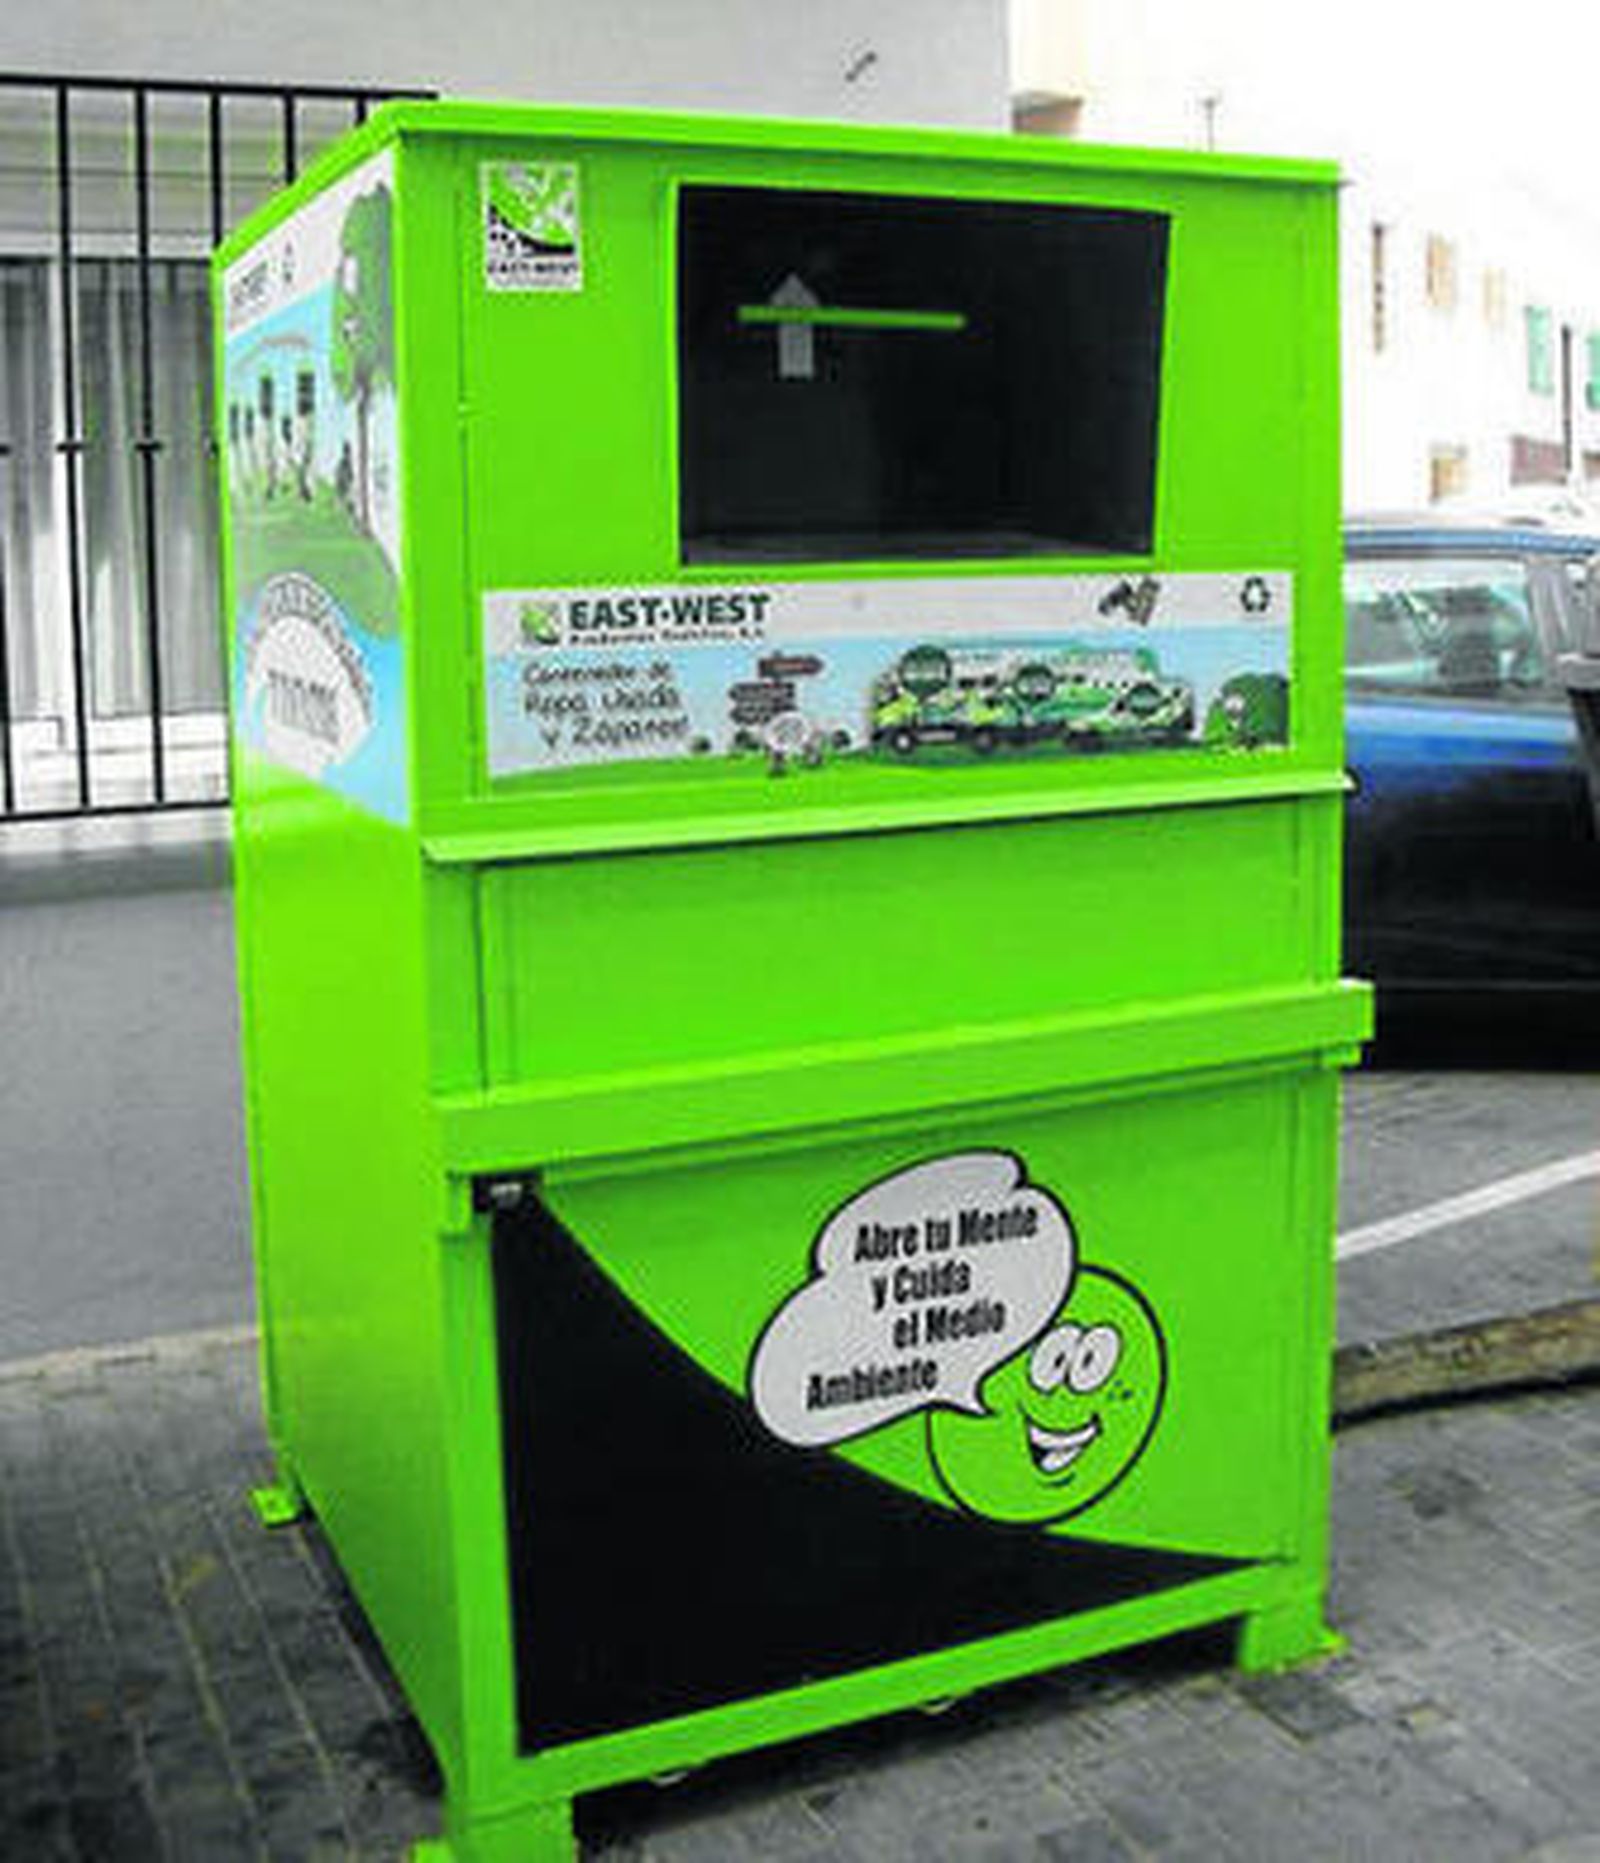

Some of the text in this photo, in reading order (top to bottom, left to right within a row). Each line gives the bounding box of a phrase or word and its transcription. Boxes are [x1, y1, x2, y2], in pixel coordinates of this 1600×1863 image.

[854, 1206, 1038, 1263] Abre tu Mente
[871, 1261, 971, 1311] y Cuida
[893, 1301, 1006, 1348] el Medio
[806, 1359, 938, 1410] Ambiente
